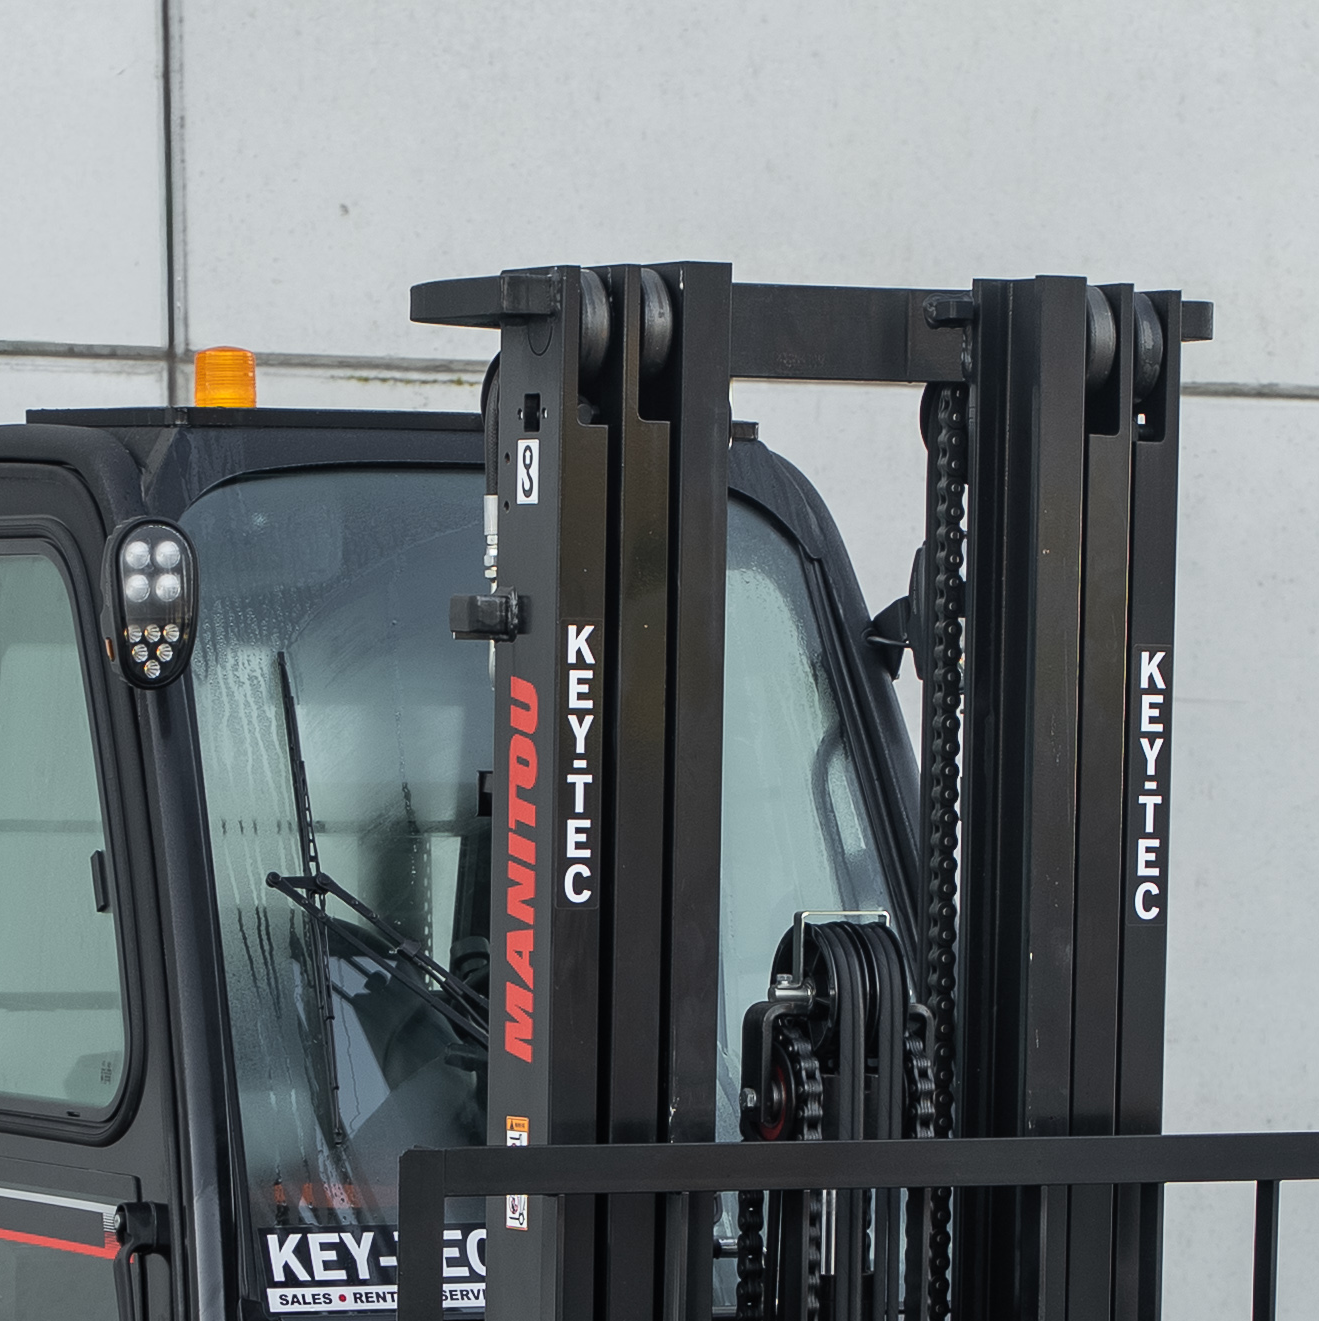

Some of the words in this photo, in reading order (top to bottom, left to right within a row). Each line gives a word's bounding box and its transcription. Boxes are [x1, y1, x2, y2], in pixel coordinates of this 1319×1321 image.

[504, 676, 538, 1063] MANITOU
[564, 624, 596, 903] KEY-TEC
[1134, 651, 1166, 920] KEY-TEC
[279, 1291, 333, 1306] SALES
[352, 1290, 398, 1304] RENT
